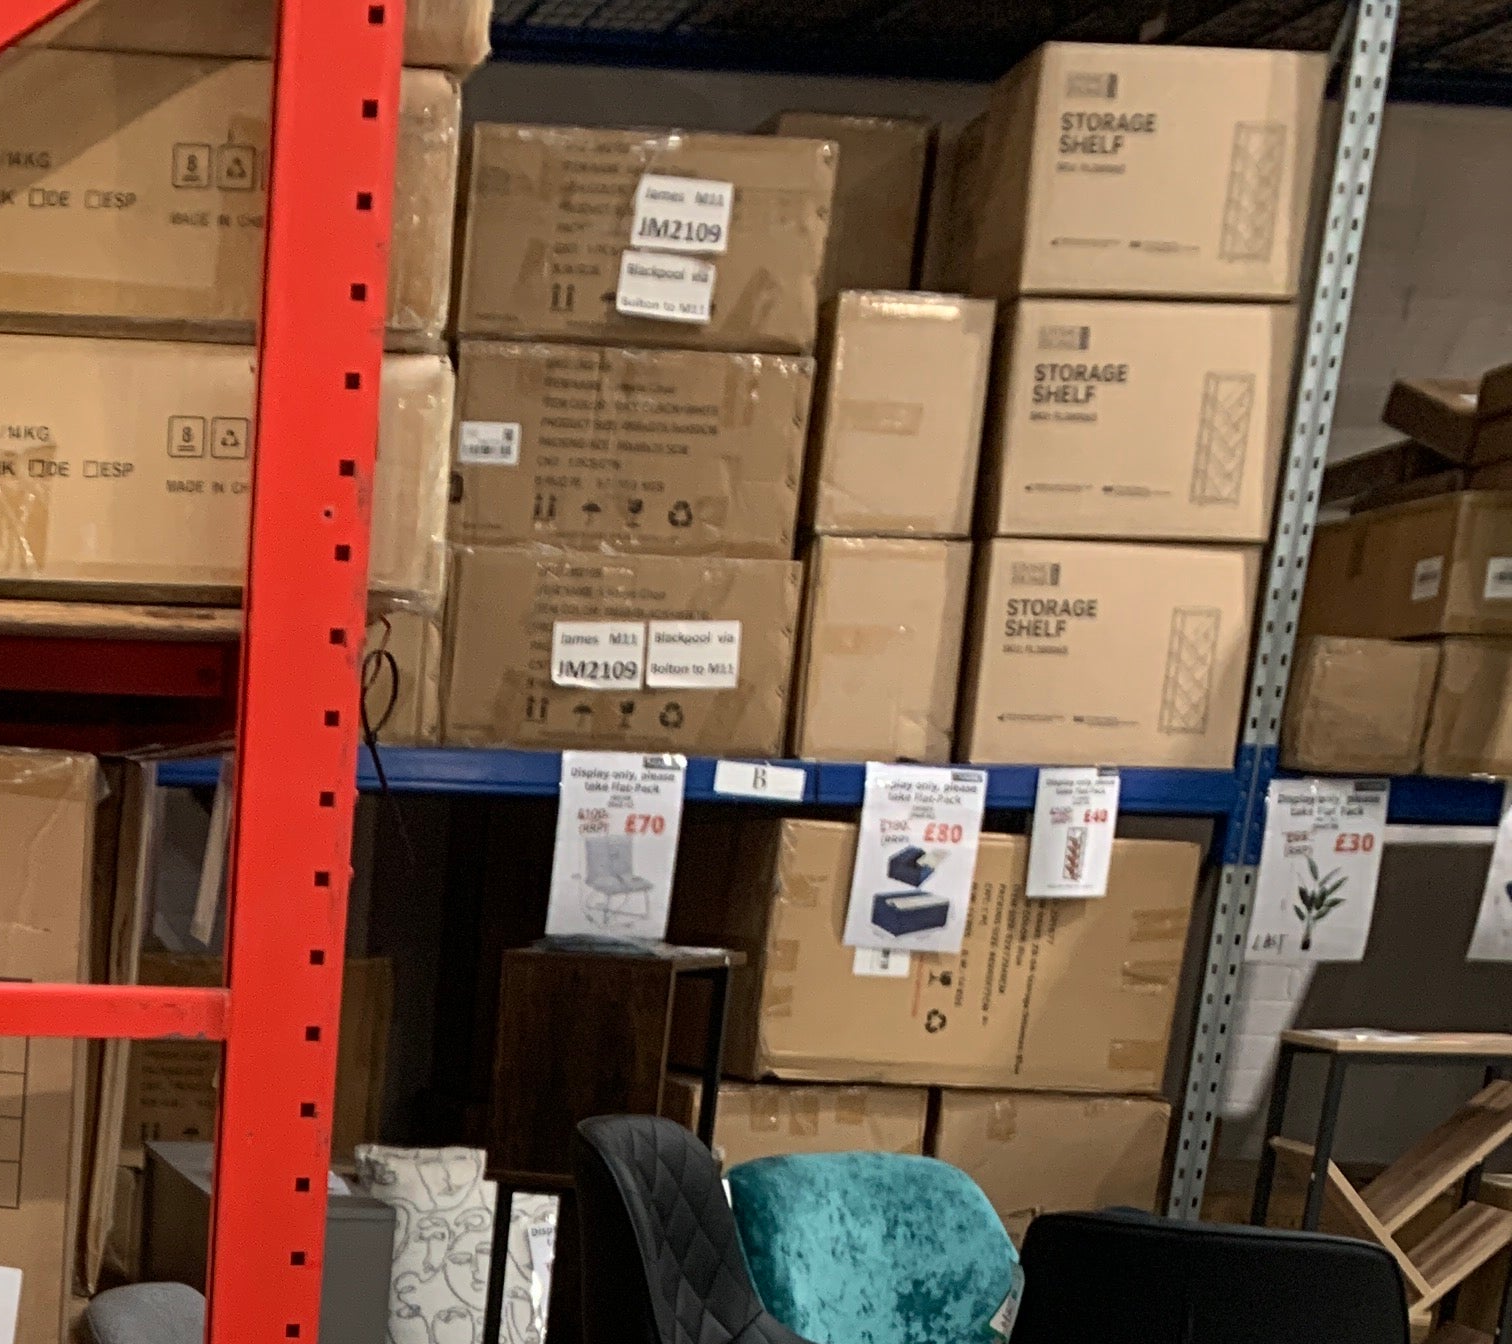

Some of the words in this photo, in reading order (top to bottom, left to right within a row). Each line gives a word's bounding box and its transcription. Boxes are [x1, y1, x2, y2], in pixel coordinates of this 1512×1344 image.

[1061, 111, 1157, 133] STORAGE
[1059, 133, 1125, 155] SHELF
[638, 216, 722, 243] JM2109
[1034, 363, 1129, 384] STORAGE
[1032, 384, 1096, 404] SHELF
[100, 462, 134, 478] ESP
[1006, 598, 1098, 618] STORAGE
[1004, 618, 1067, 638] SHELF
[655, 631, 711, 647] Blackpool
[718, 634, 734, 645] via
[557, 659, 639, 681] JM2109
[752, 767, 767, 789] B
[624, 814, 665, 835] £70
[1335, 833, 1375, 853] £30
